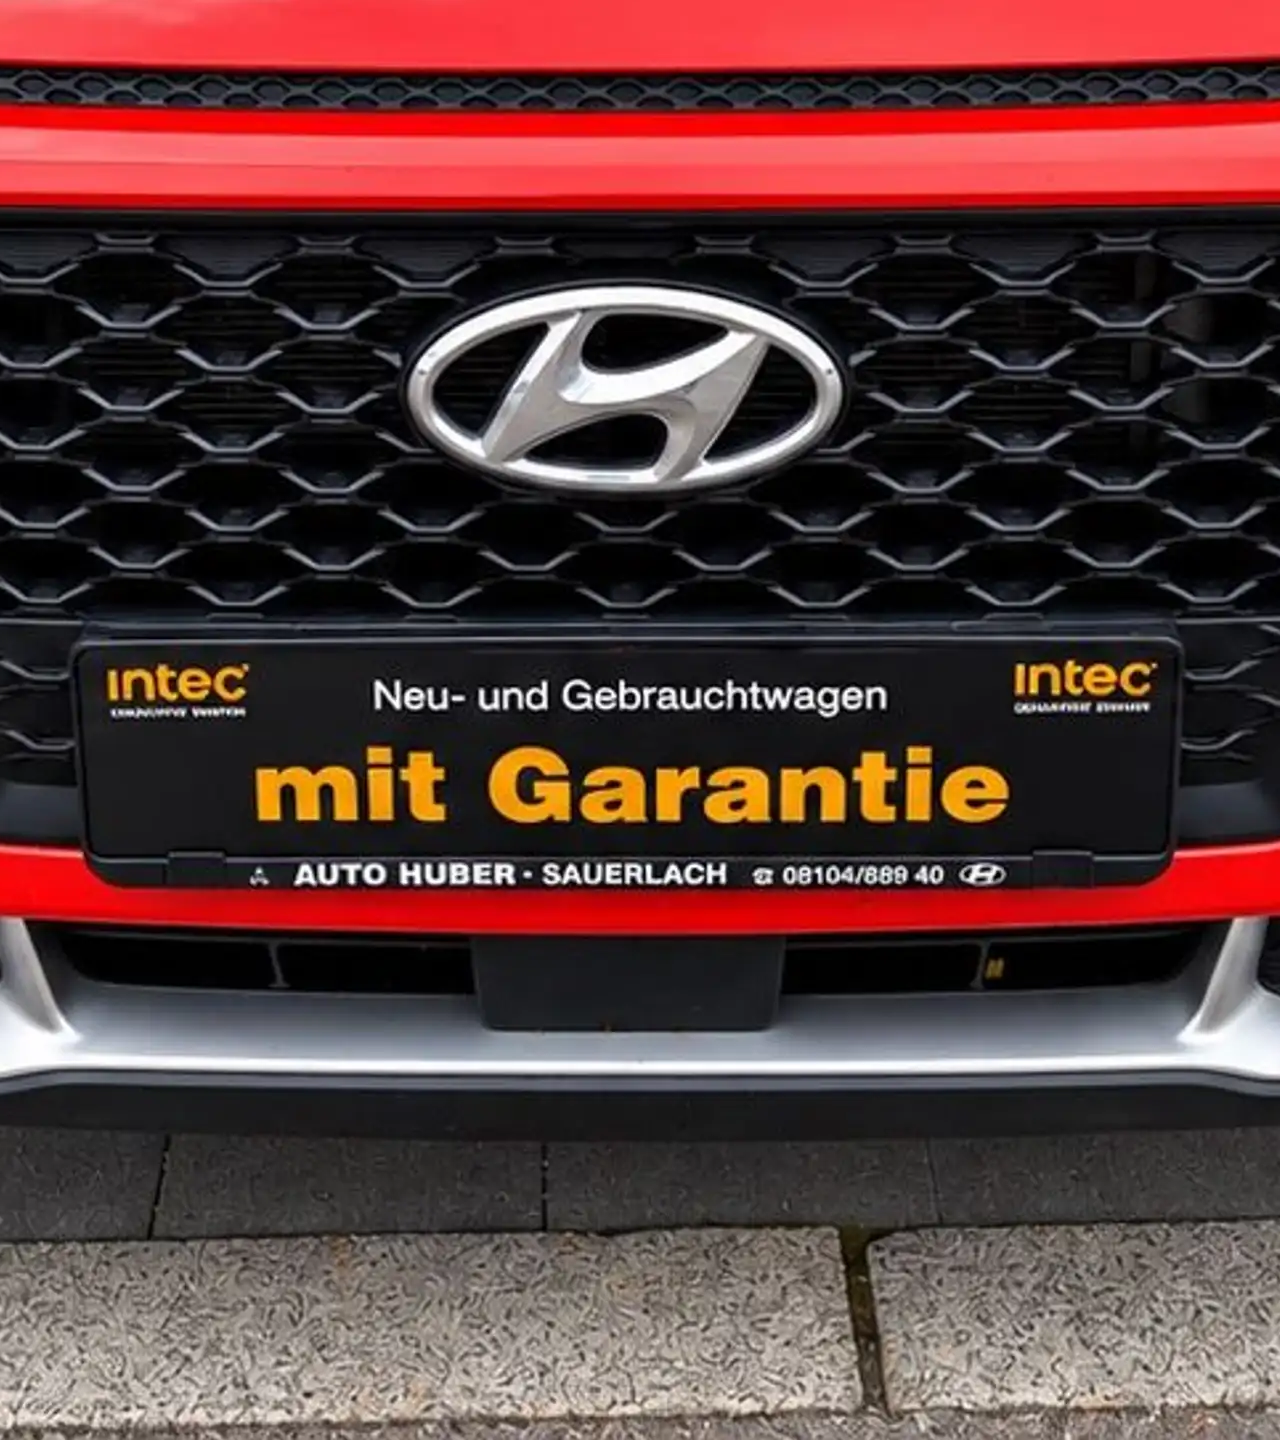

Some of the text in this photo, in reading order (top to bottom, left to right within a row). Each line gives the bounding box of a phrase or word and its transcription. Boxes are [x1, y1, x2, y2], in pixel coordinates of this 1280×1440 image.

[373, 678, 887, 718] Neu- und Gebrauchtwagen
[255, 745, 1010, 824] mit Garantie
[293, 862, 387, 886] AUTO
[399, 862, 517, 886] HUBER
[542, 862, 727, 886] SAUERLACH
[913, 864, 945, 885] 40
